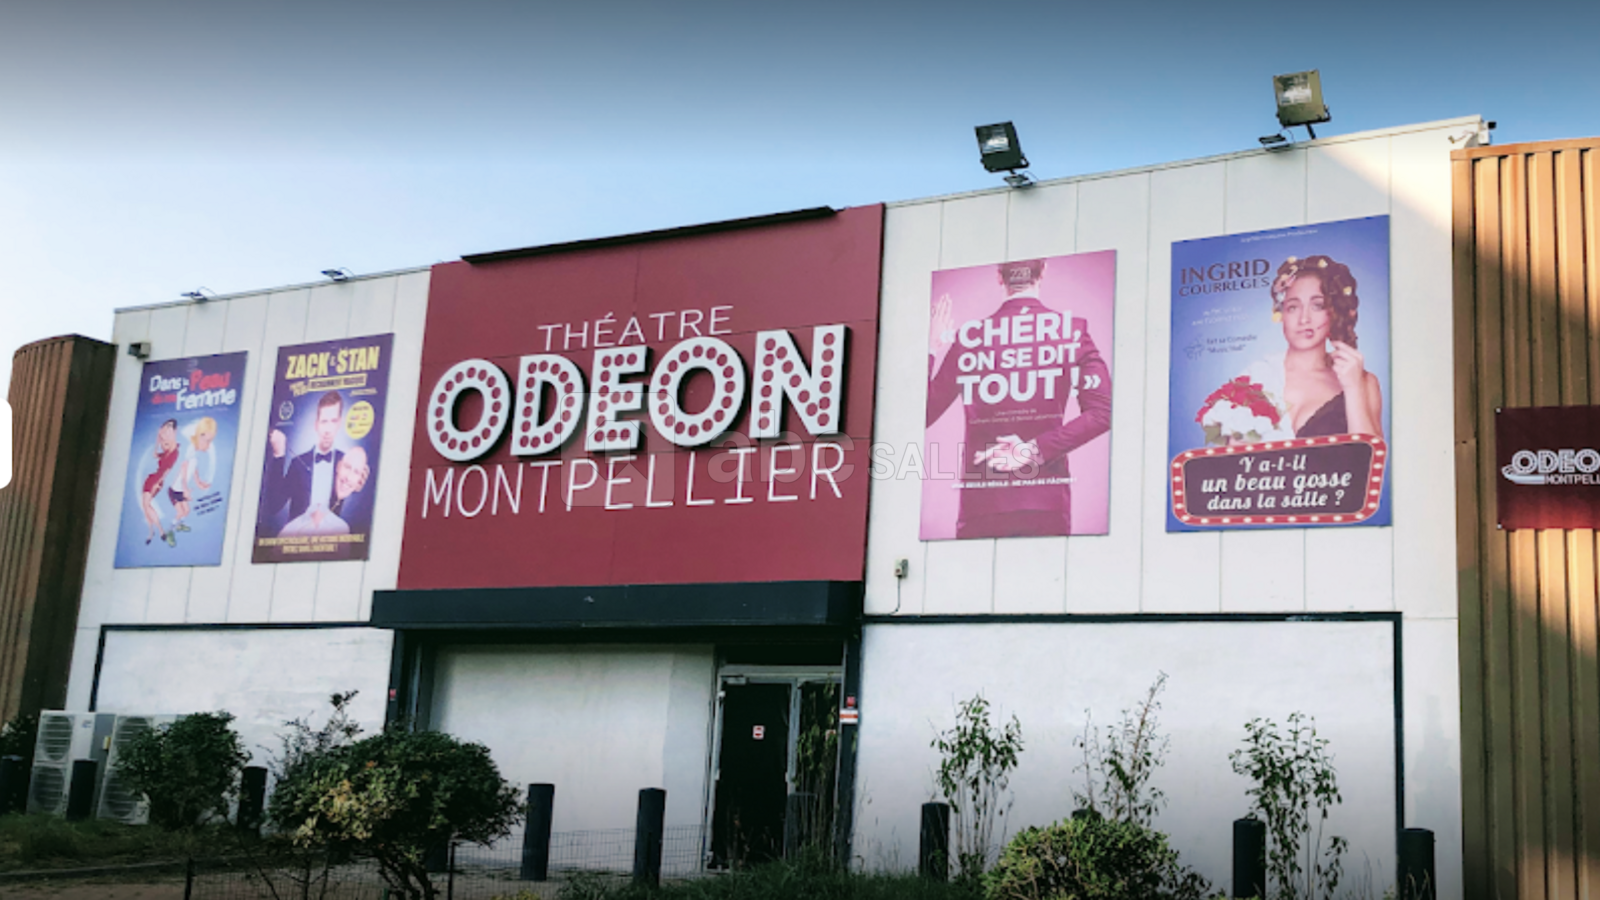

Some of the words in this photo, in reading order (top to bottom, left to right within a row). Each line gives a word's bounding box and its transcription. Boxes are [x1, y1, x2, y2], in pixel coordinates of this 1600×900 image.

[1181, 258, 1270, 285] INGRID
[537, 305, 733, 351] THÉATRE
[285, 352, 330, 380] ZACK
[336, 346, 381, 374] STAN
[958, 350, 995, 373] ON
[1000, 347, 1033, 369] SE
[1038, 342, 1081, 366] DIT
[149, 374, 181, 392] Dans
[189, 370, 231, 391] Peau
[427, 324, 849, 462] ODEON
[956, 368, 1064, 405] TOUT
[176, 387, 236, 411] Femme
[1239, 456, 1255, 473] Y
[422, 443, 844, 518] MONTPELLIER
[1201, 478, 1228, 493] un
[1234, 473, 1286, 491] beau
[1292, 472, 1352, 494] gosse
[1207, 495, 1252, 511] dans
[1257, 493, 1276, 509] la
[1281, 491, 1328, 508] salle
